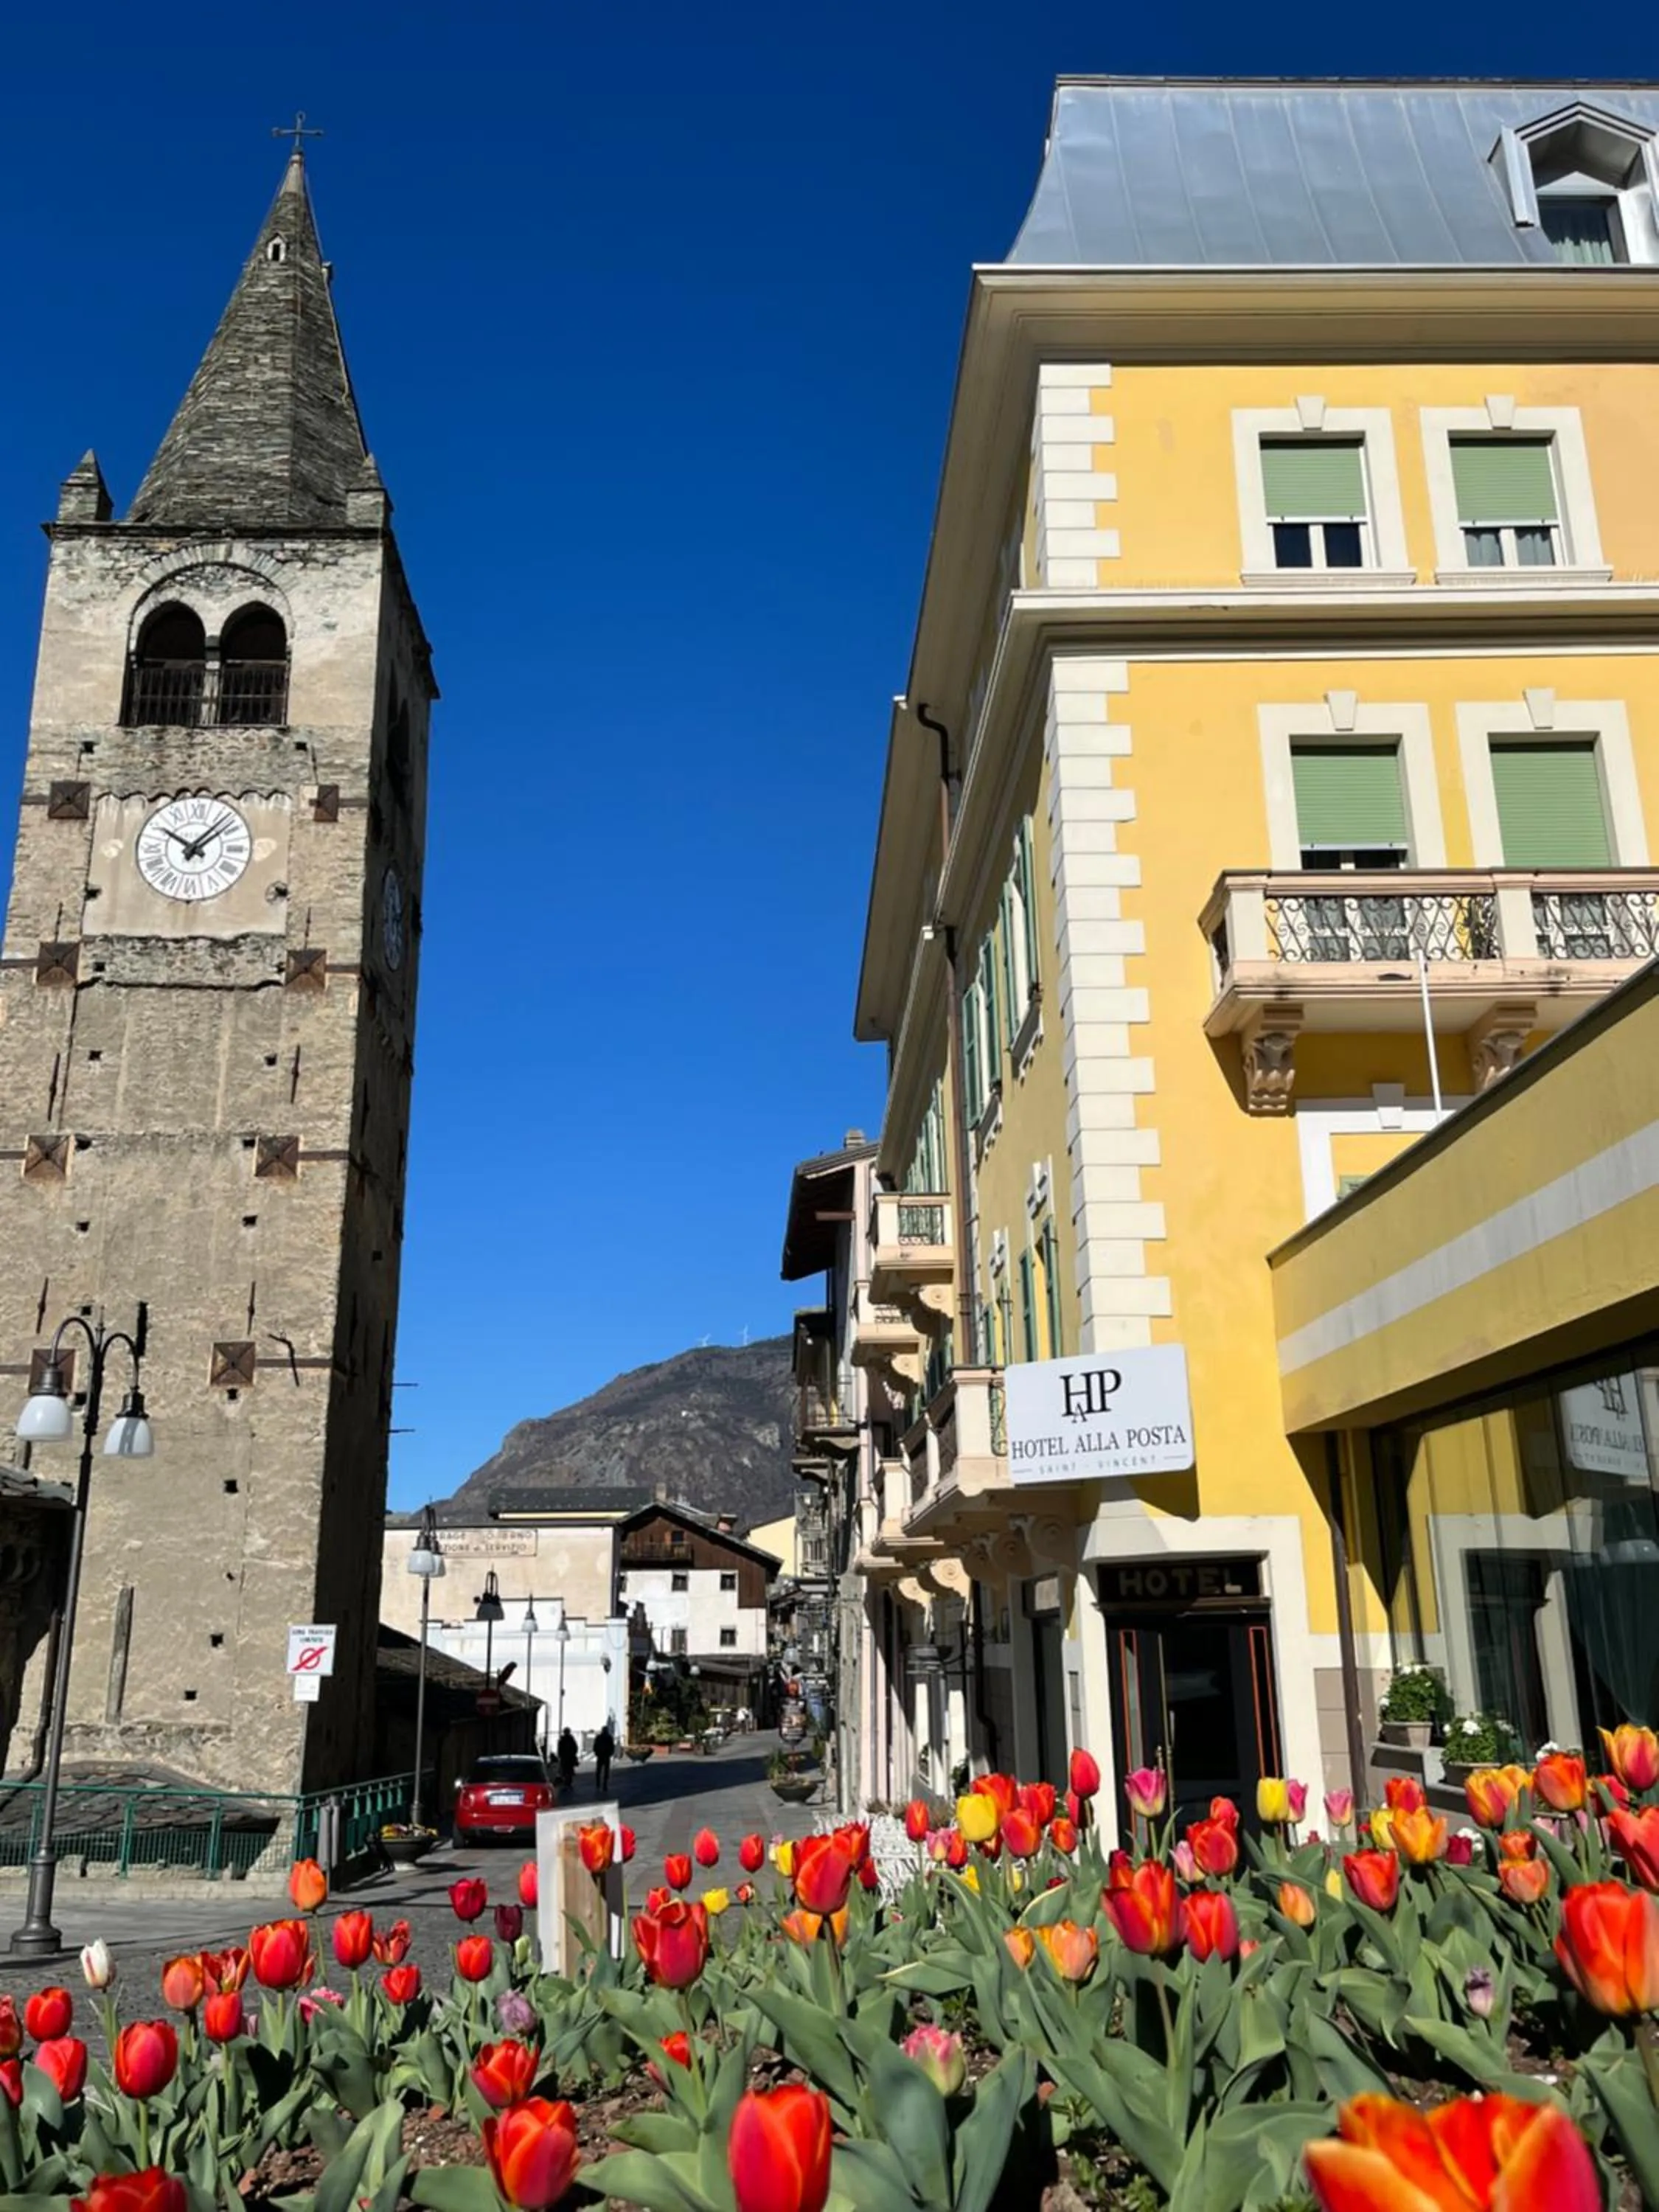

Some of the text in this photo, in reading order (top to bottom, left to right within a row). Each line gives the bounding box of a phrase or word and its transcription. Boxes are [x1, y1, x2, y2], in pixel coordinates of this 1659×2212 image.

[1012, 1425, 1186, 1459] HOTEL ALLA POSTA
[1098, 1455, 1156, 1469] VINCENT
[1119, 1567, 1242, 1596] HOTEL
